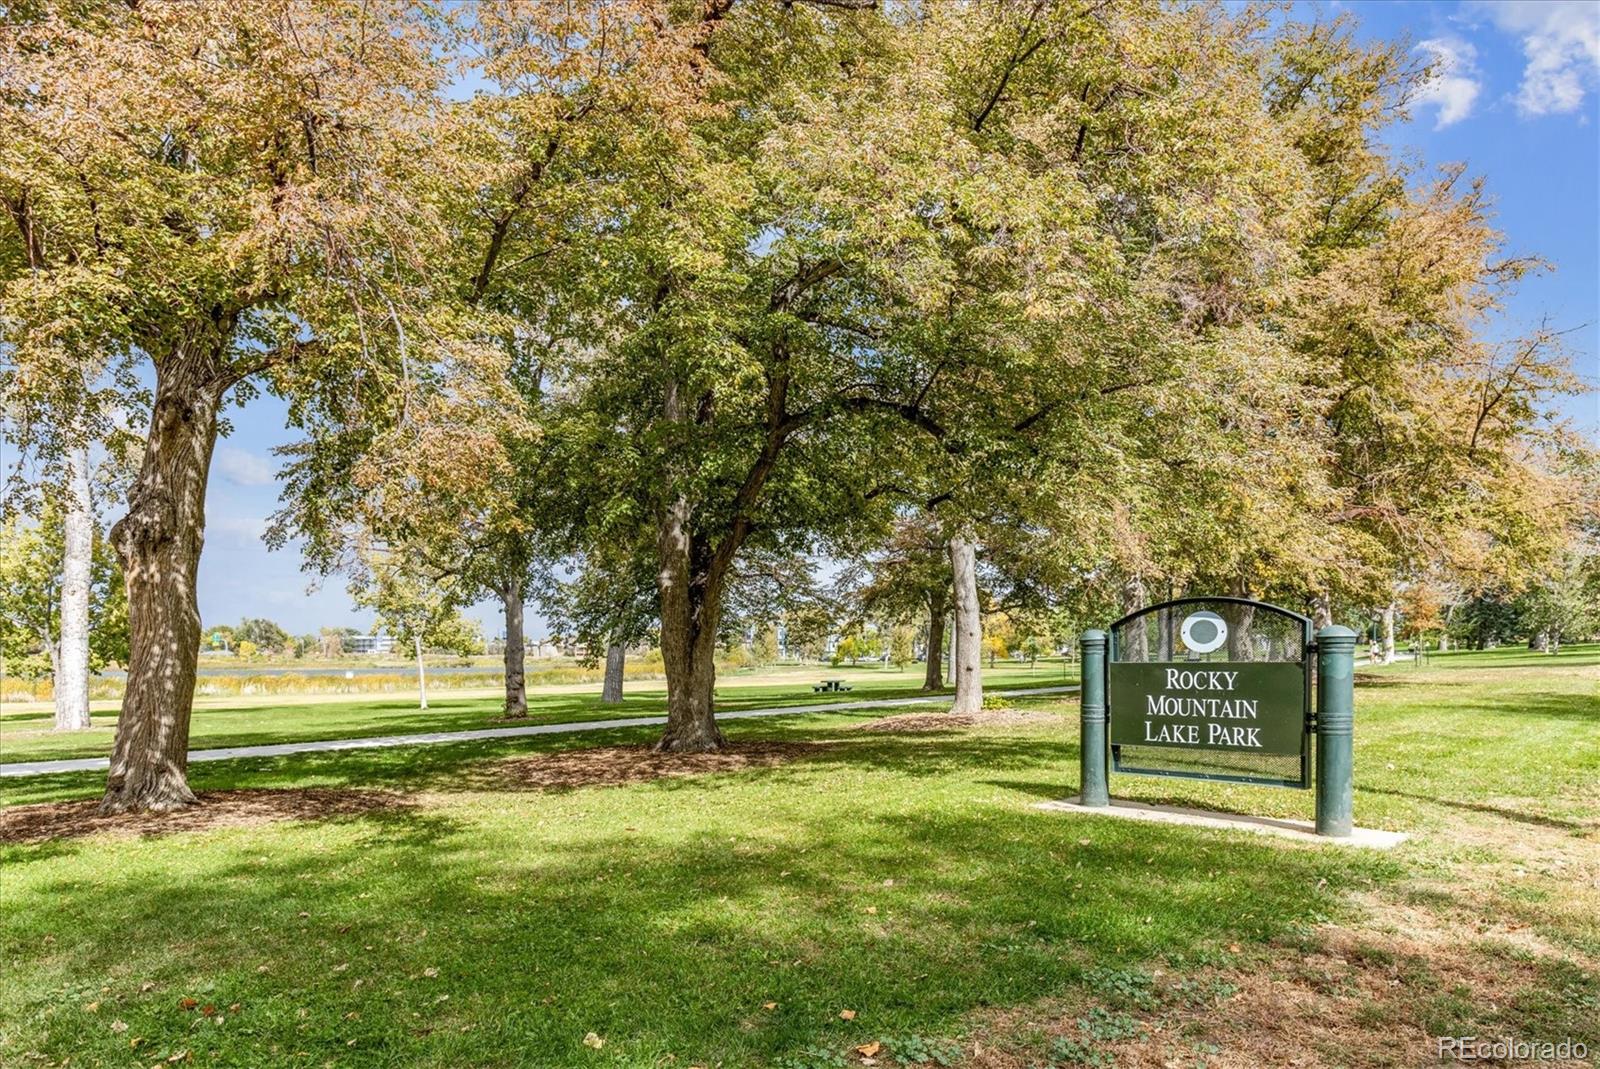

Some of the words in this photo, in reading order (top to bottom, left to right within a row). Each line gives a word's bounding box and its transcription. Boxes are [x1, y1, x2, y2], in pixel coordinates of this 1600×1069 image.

[1166, 668, 1238, 690] ROCKY
[1146, 695, 1258, 719] MOUNTAIN
[1144, 721, 1200, 744] LAKE
[1207, 723, 1263, 748] PARK
